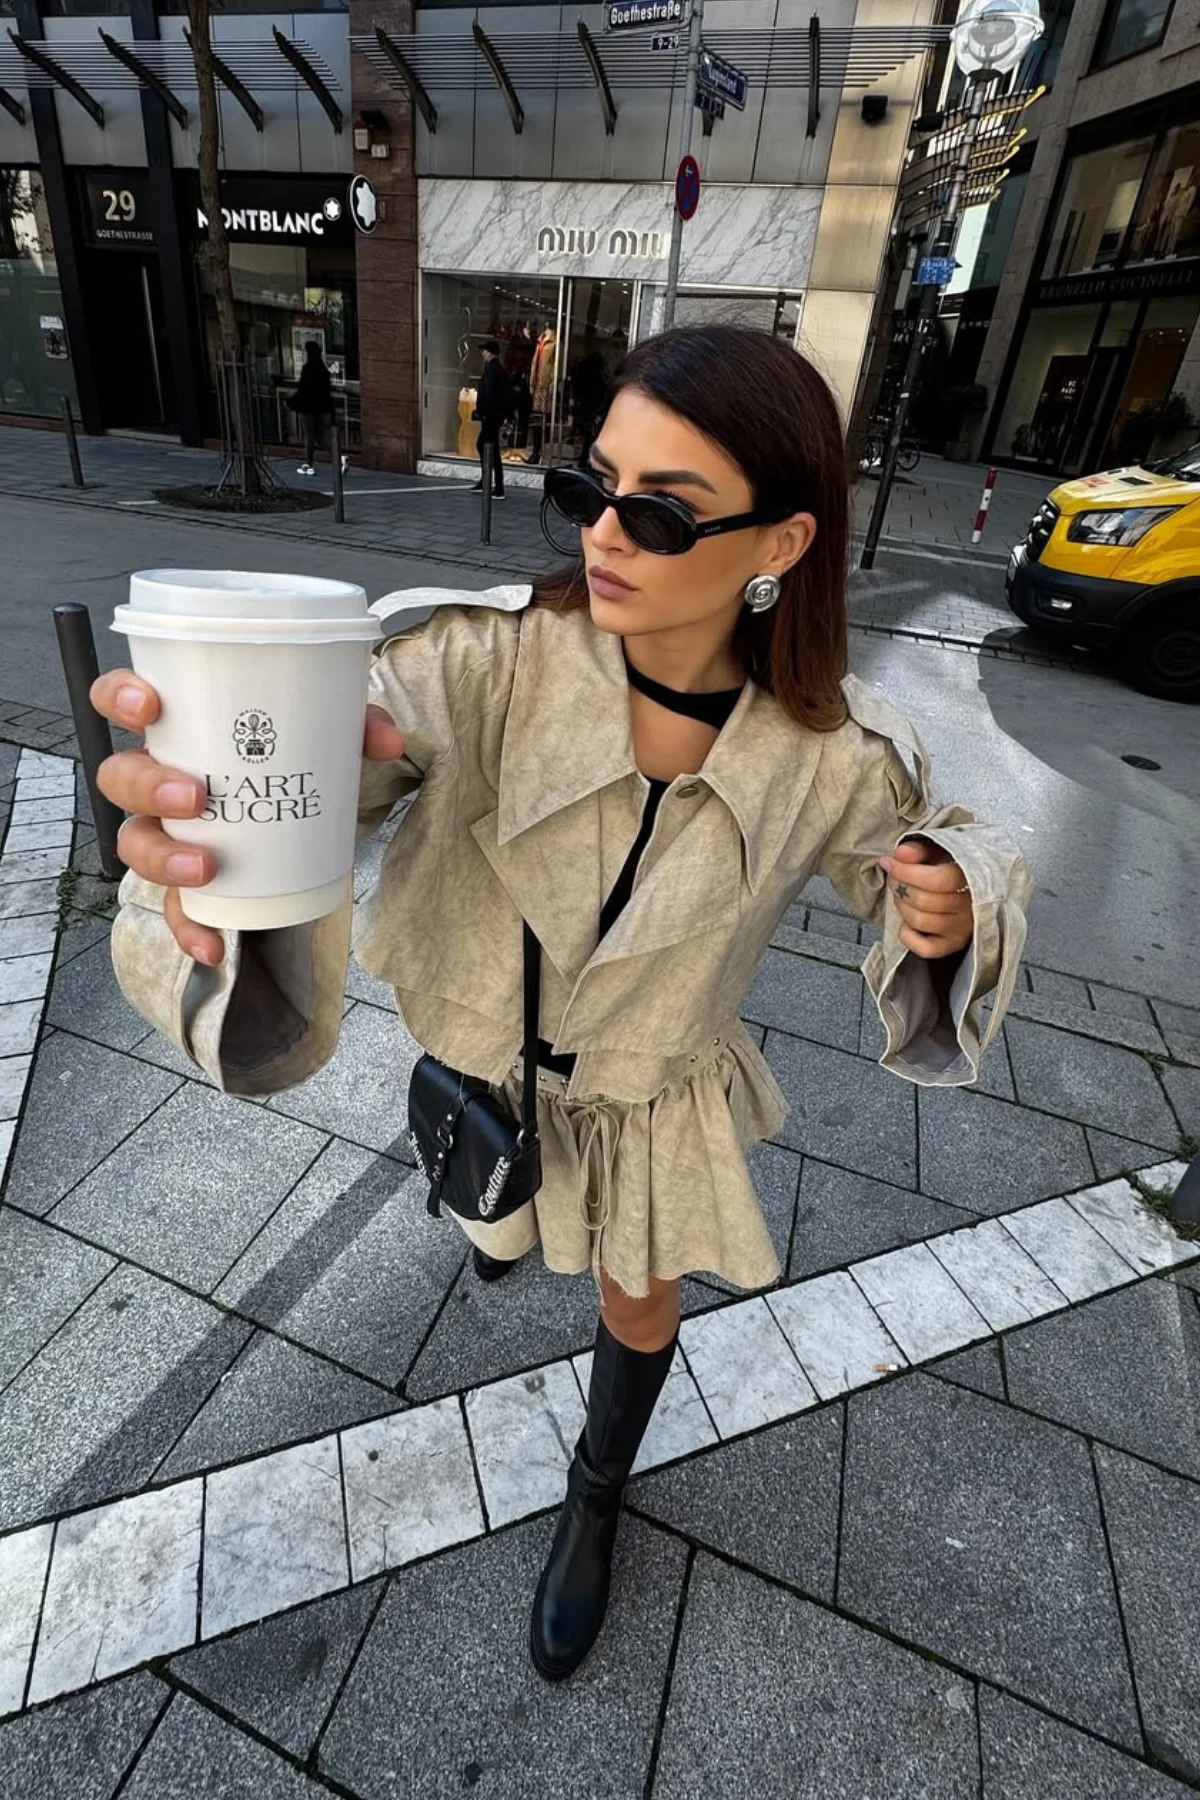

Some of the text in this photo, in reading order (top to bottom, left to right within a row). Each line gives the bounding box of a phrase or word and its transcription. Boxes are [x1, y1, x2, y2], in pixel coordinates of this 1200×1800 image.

[611, 1, 681, 25] Goethestraße
[658, 36, 679, 49] 9-29
[102, 190, 136, 221] 29
[205, 772, 313, 798] L'ART
[199, 789, 321, 824] SUCRÉ
[478, 1156, 509, 1216] Couture
